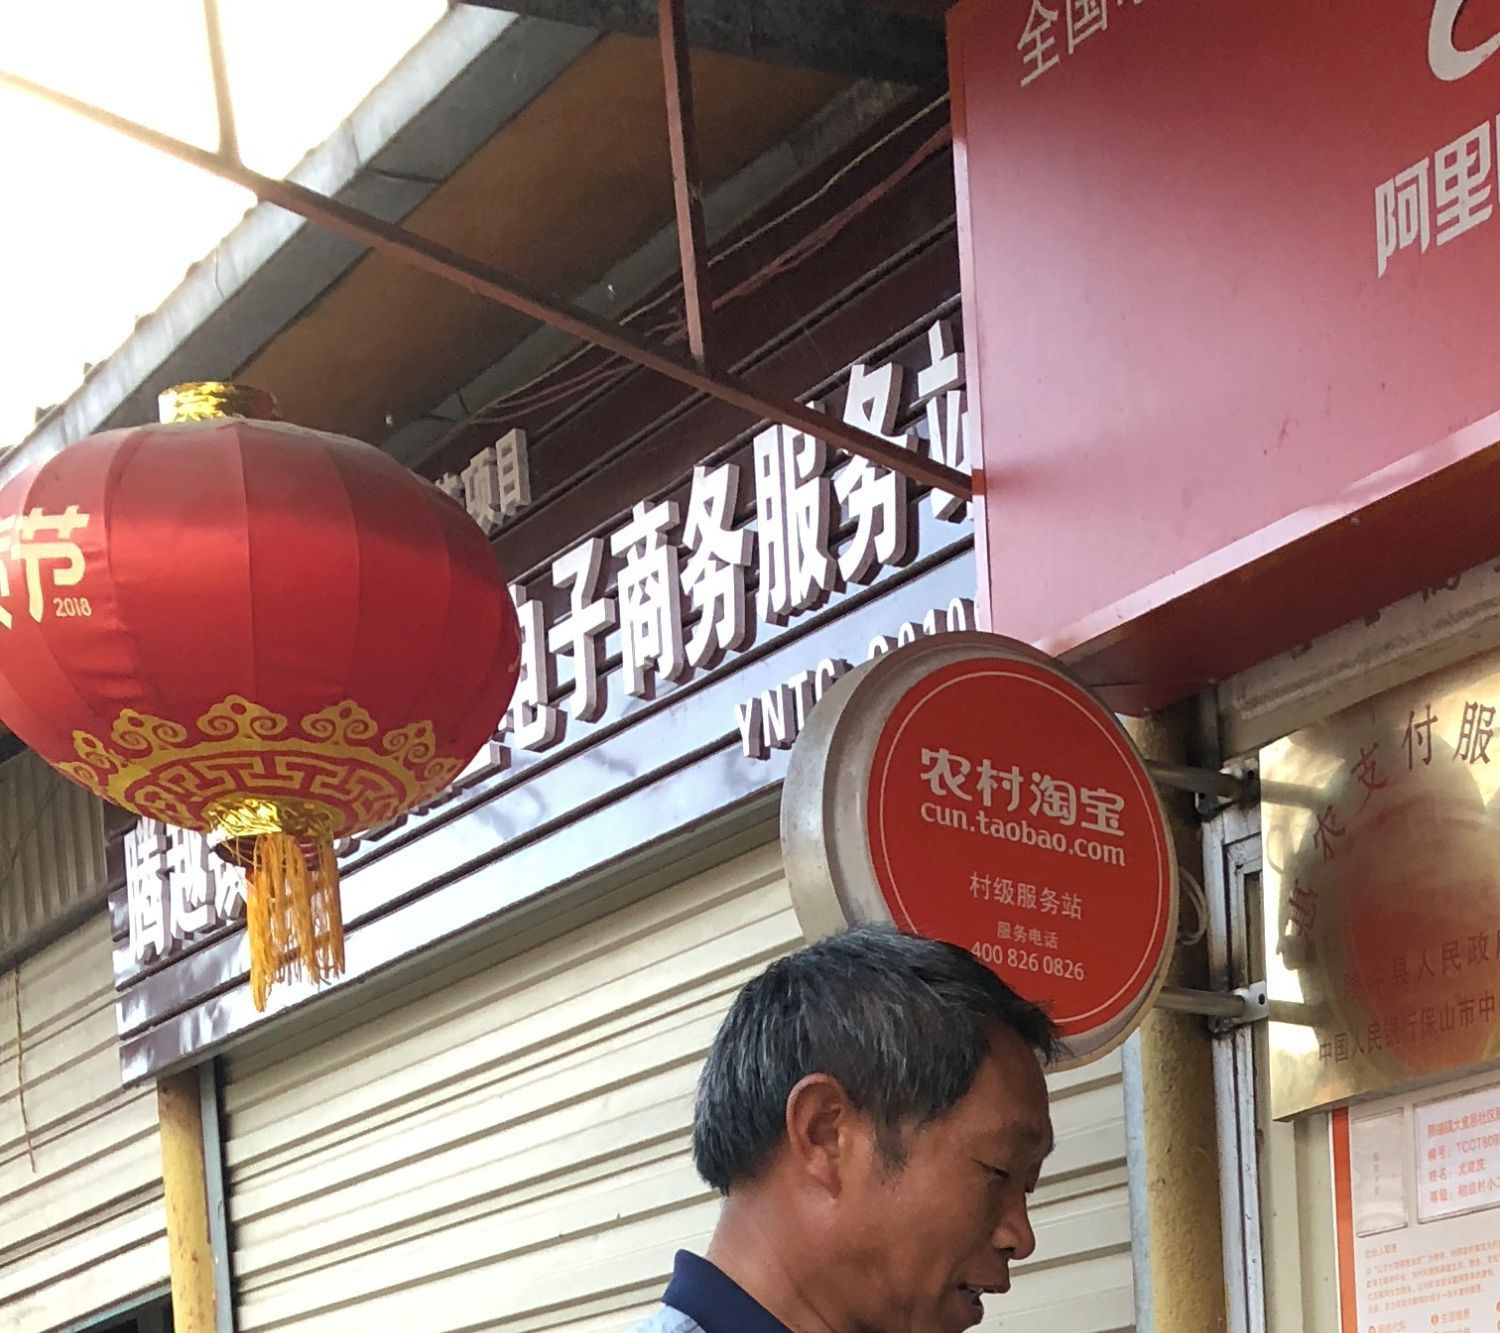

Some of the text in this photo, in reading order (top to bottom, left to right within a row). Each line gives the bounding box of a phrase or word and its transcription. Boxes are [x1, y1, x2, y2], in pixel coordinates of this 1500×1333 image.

[1017, 0, 1143, 87] 全国
[53, 597, 92, 617] 2018
[920, 747, 1126, 837] 农村淘宝
[920, 802, 1126, 867] cun.taobao.com
[969, 871, 1083, 921] 村级服务站
[996, 920, 1059, 950] 服务电话
[970, 940, 1085, 982] 400 826 0826
